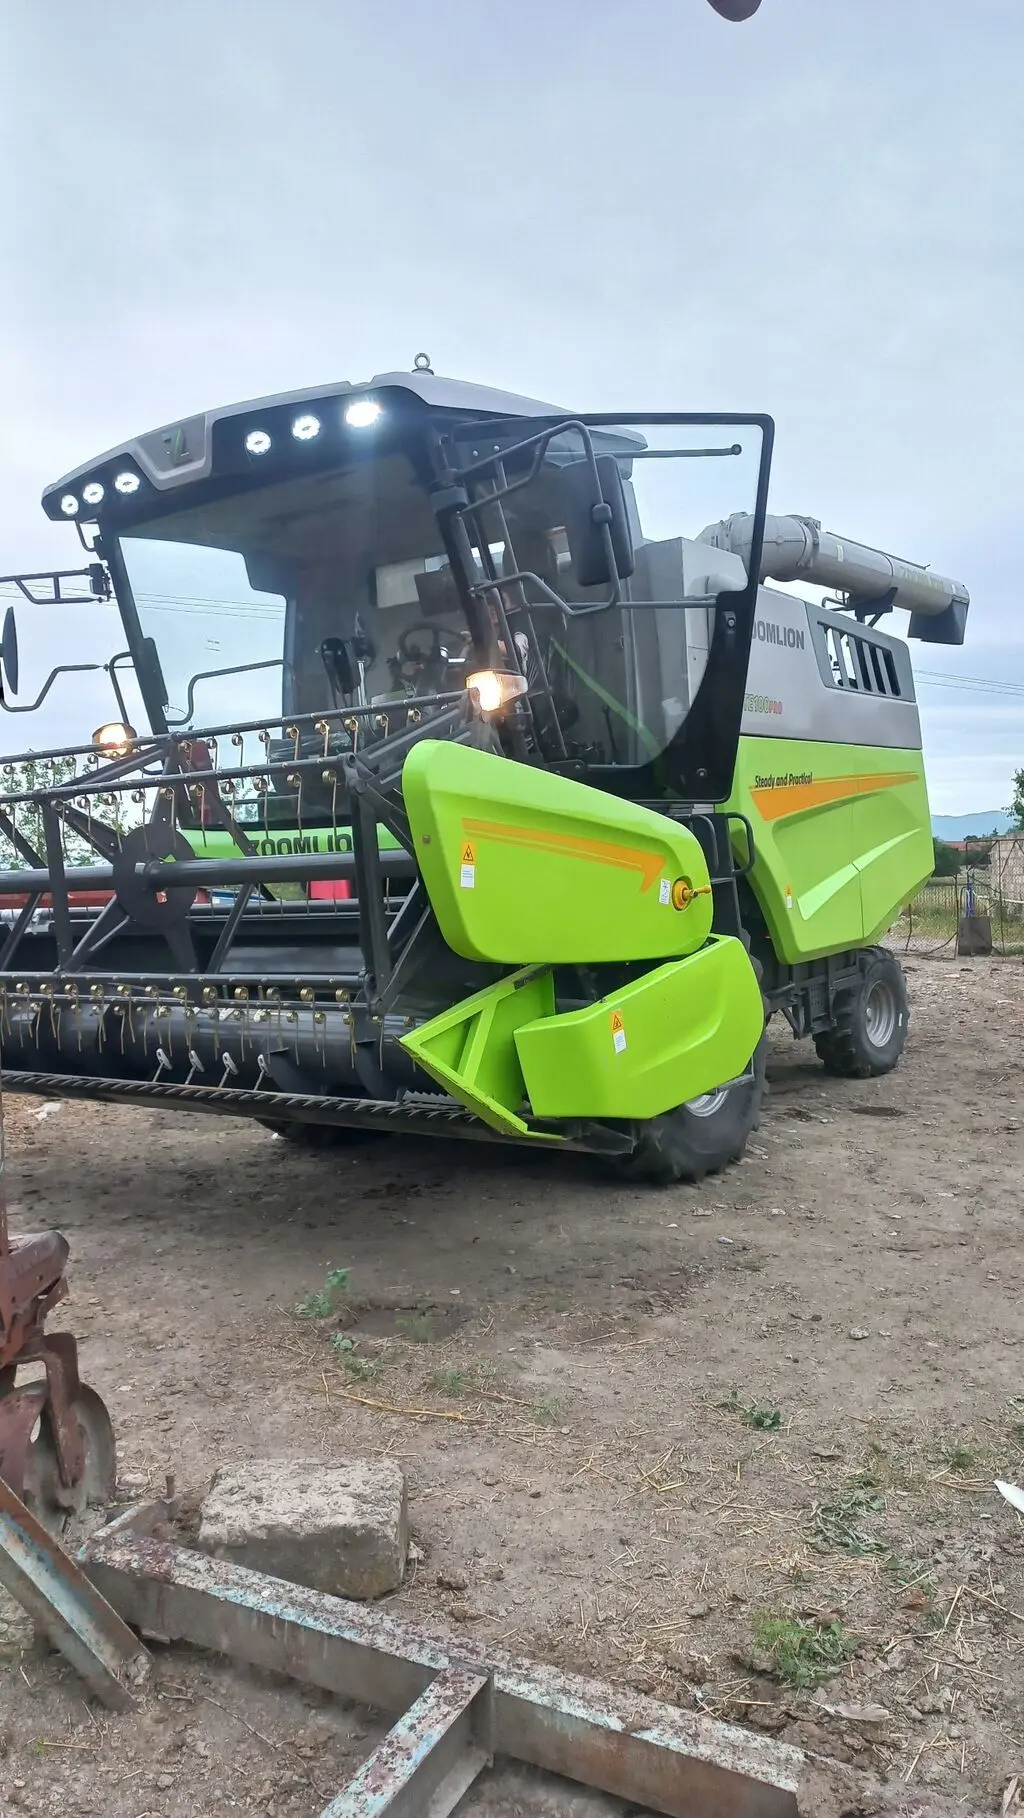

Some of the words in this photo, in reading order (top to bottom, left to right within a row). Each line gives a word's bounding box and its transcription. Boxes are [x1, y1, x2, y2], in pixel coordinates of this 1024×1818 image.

[755, 774, 775, 789] Steady
[776, 773, 788, 786] and
[789, 772, 813, 786] Practical
